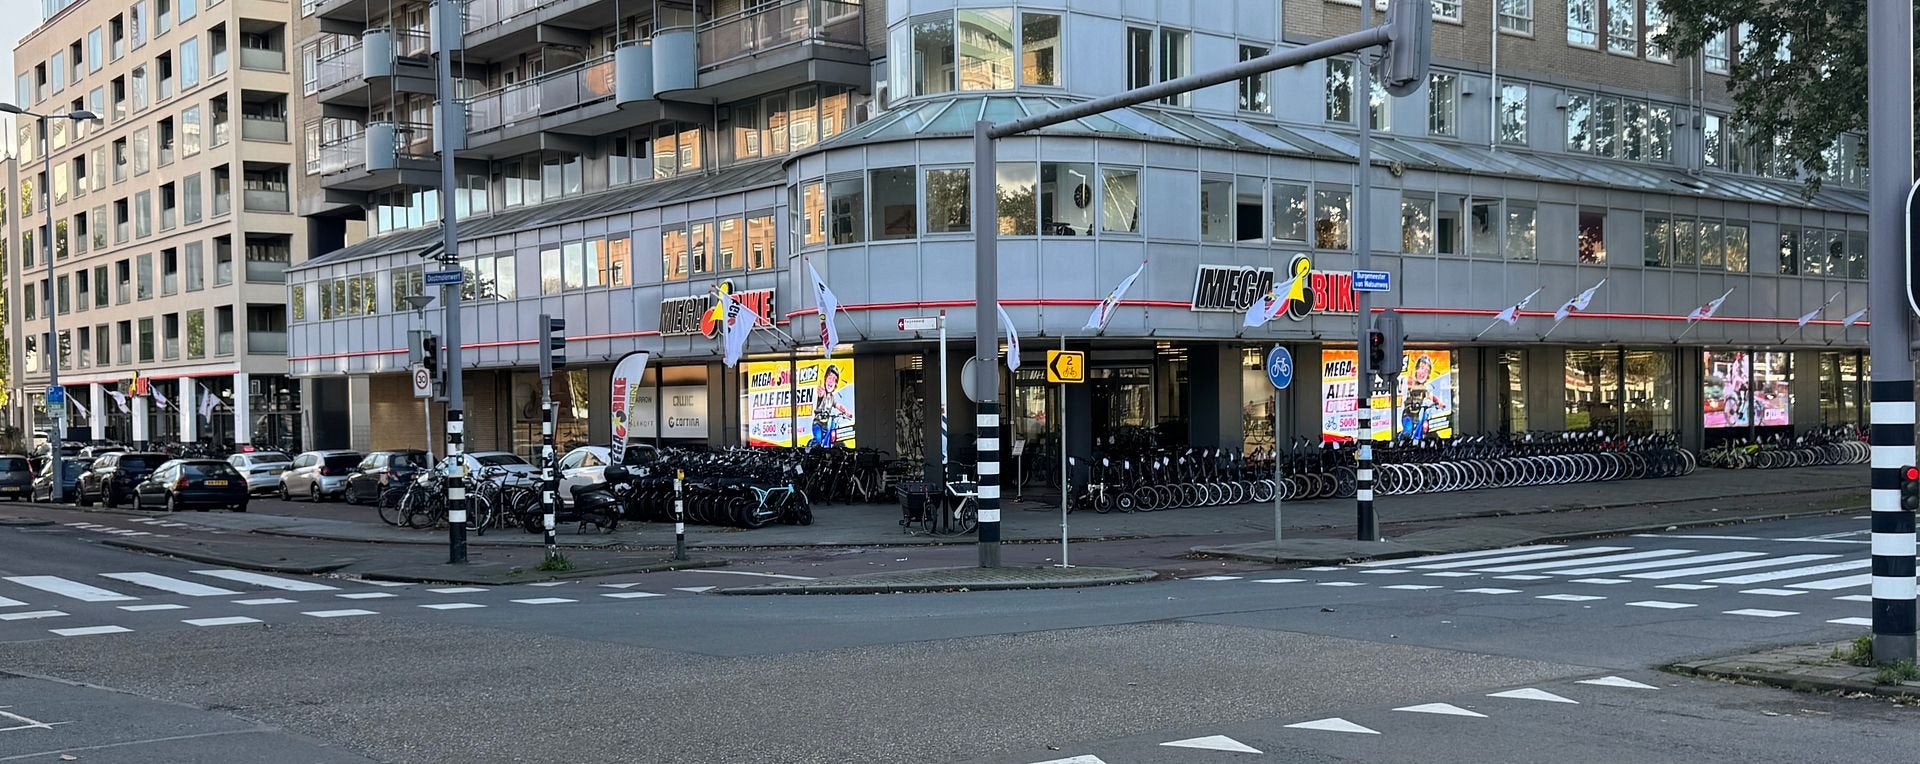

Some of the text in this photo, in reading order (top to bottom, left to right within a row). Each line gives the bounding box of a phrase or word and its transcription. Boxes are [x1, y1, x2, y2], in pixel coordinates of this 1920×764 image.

[1193, 265, 1274, 311] MEGA
[659, 295, 711, 335] MEGA
[1067, 356, 1073, 365] 2
[1325, 360, 1352, 377] MEGA
[752, 372, 772, 387] MEGA
[800, 366, 818, 382] KIDS
[613, 377, 627, 412] BIKE
[1326, 382, 1355, 399] ALLE
[753, 392, 775, 407] ALLE
[762, 424, 777, 434] 5000
[1339, 418, 1357, 428] 5000
